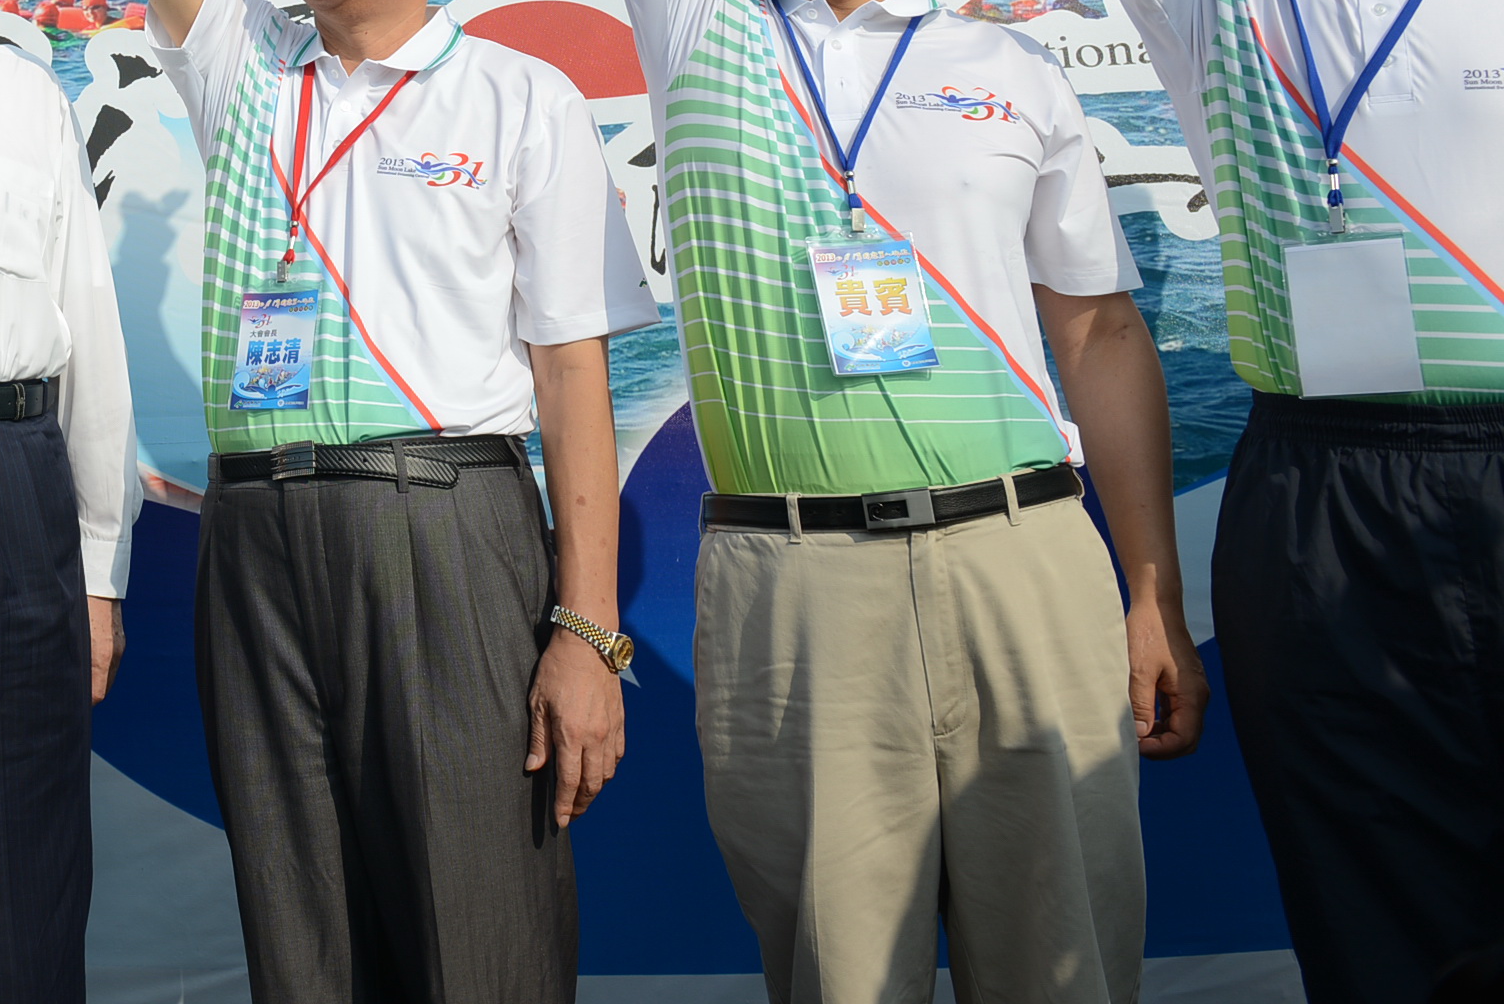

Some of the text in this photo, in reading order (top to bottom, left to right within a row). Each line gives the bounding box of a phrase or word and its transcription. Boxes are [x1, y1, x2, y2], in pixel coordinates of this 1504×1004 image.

[1463, 69, 1501, 79] 2013
[895, 92, 926, 102] 2013
[379, 157, 405, 167] 2013
[817, 254, 835, 262] 2013
[835, 277, 913, 317] 貴賓
[246, 338, 302, 366] 陳志清
